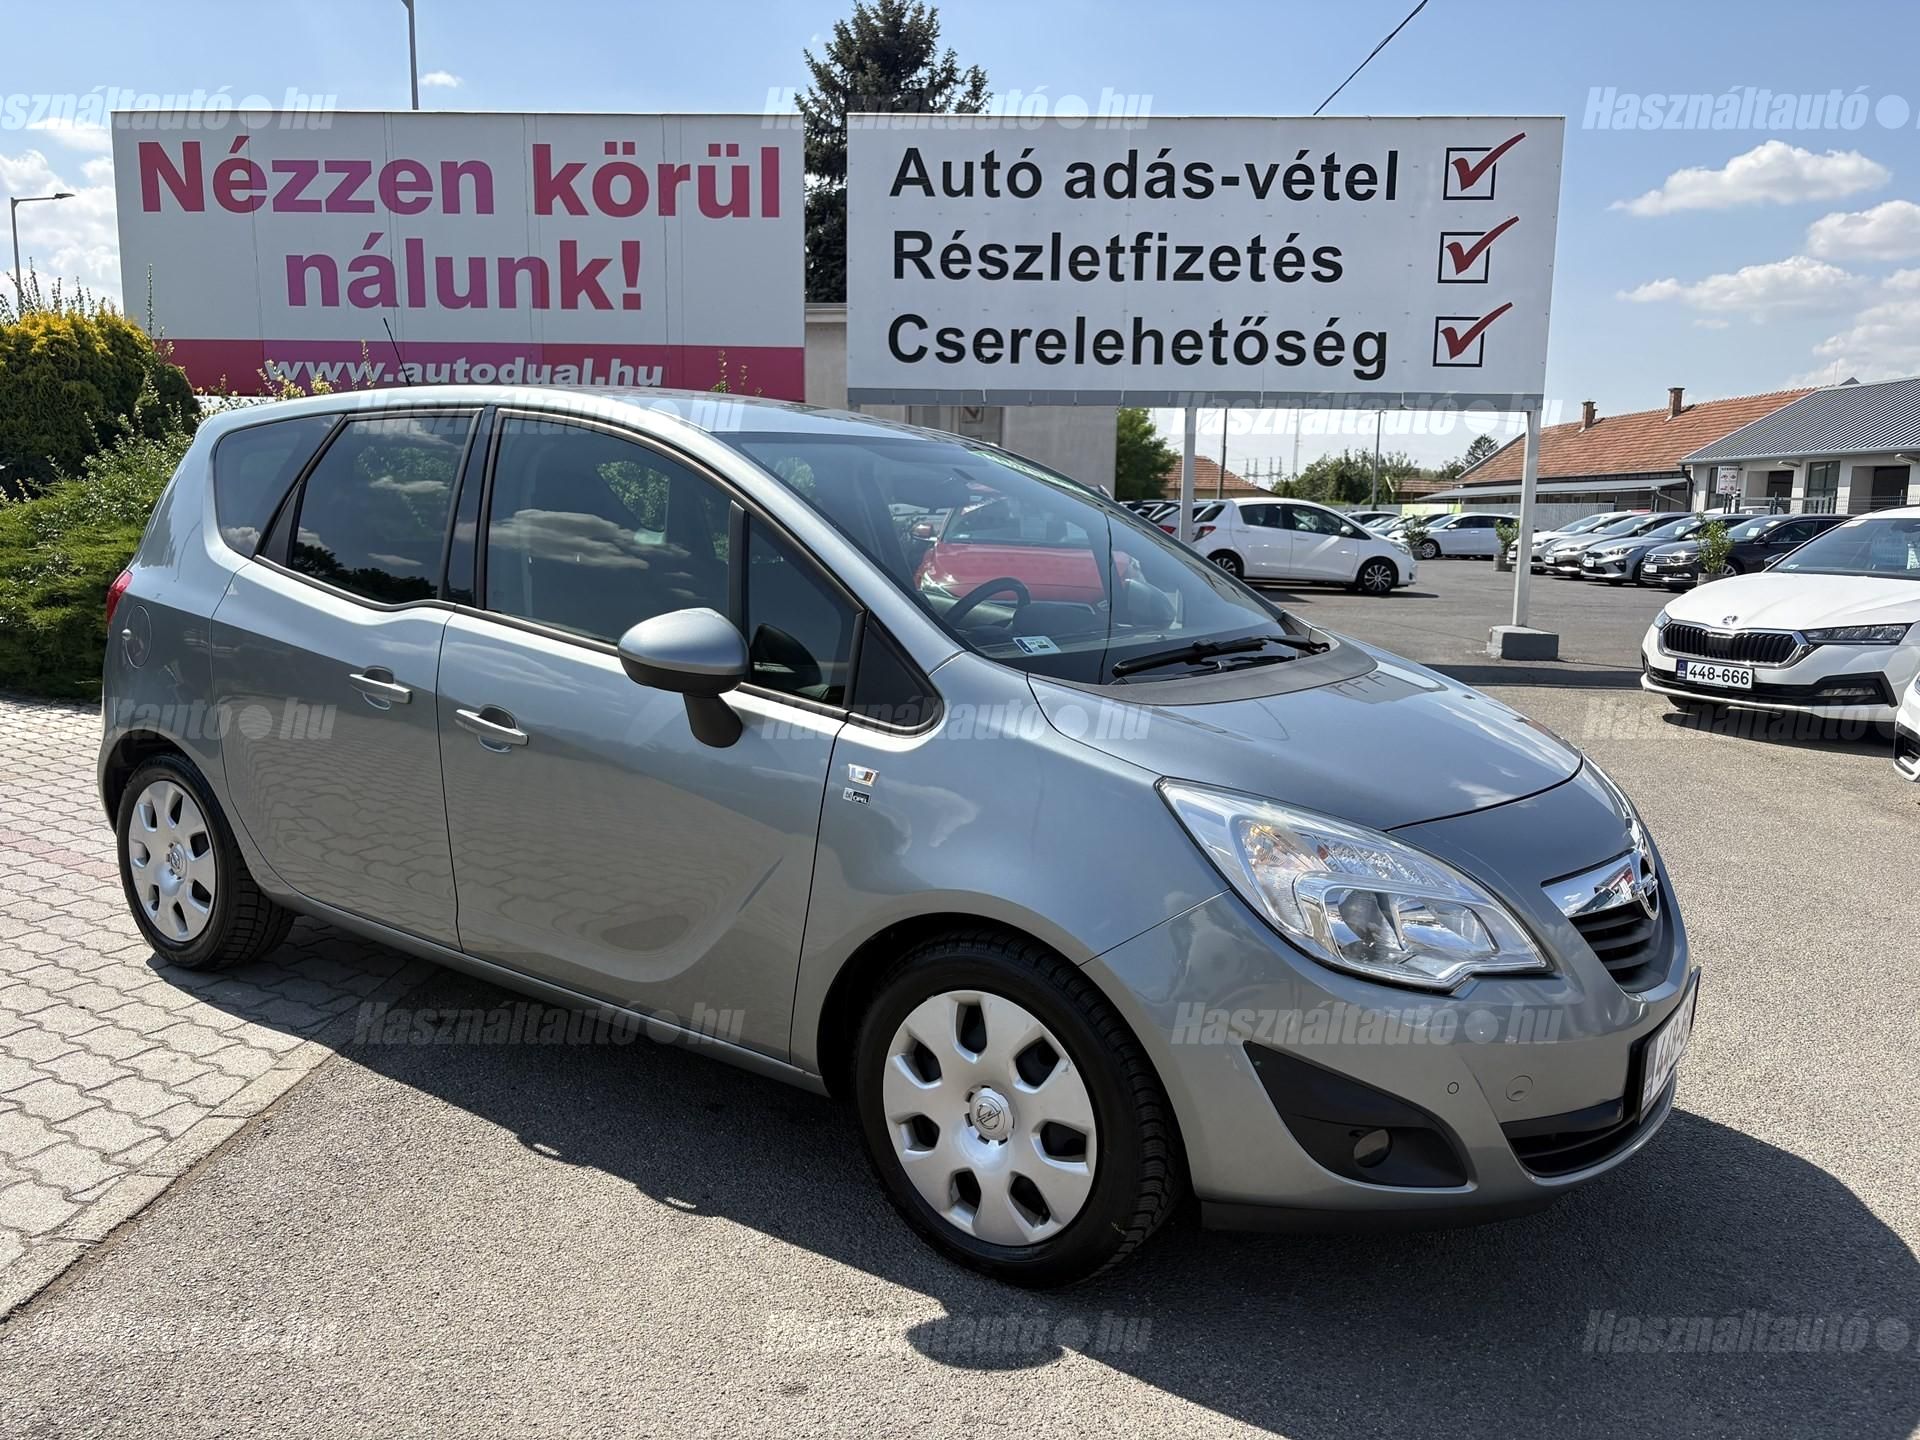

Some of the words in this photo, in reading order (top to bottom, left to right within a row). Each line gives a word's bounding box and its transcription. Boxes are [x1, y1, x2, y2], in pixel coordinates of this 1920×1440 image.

[138, 136, 495, 215] Nézzen
[533, 141, 781, 218] körül
[889, 147, 1043, 200] Autó
[1063, 148, 1399, 201] adás-vétel
[286, 232, 641, 310] nálunk!
[893, 230, 1344, 283] Részletfizetés
[264, 356, 663, 387] www.autodual.hu
[887, 313, 1388, 381] Cserelehetőség
[1689, 664, 1750, 685] 448-666
